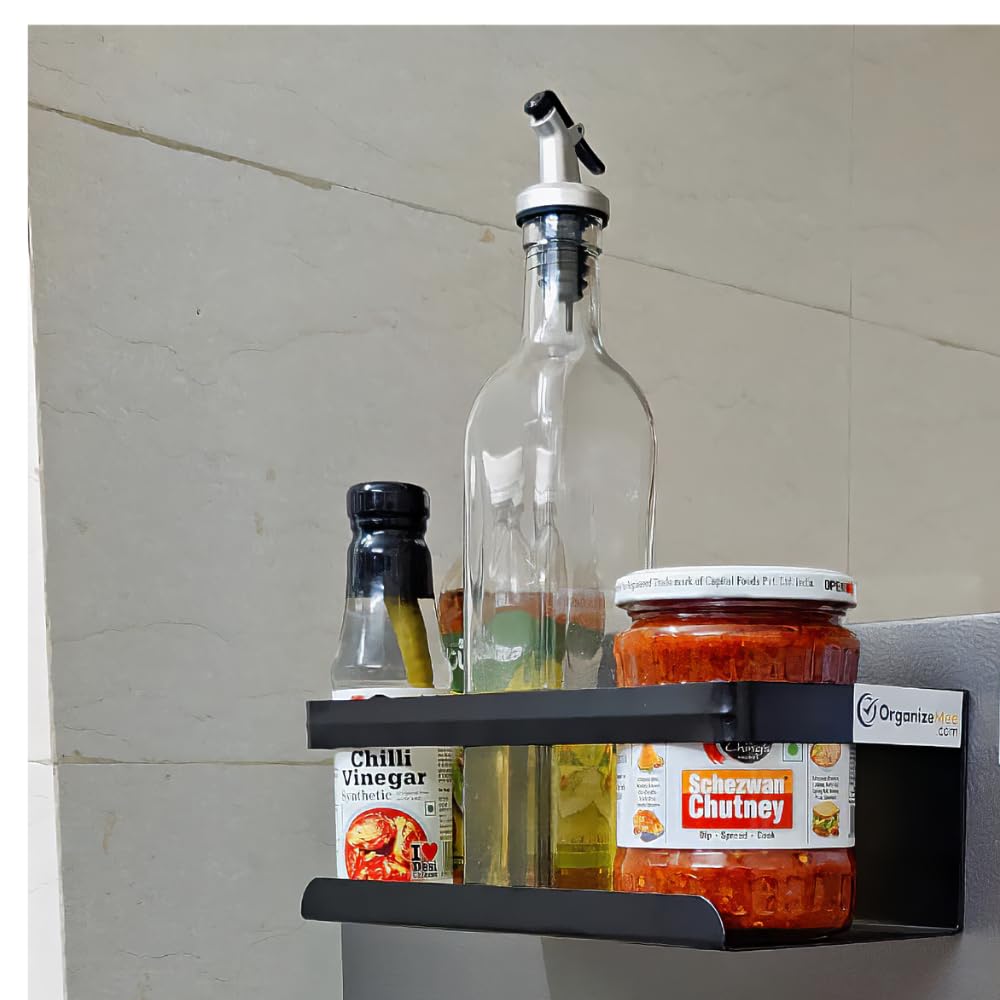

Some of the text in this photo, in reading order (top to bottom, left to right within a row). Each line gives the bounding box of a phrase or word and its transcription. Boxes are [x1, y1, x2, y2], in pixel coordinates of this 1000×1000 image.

[351, 750, 412, 768] Chilli
[342, 769, 427, 790] Vinegar
[688, 772, 785, 794] Schezwan
[341, 789, 393, 801] Synthetic
[688, 794, 785, 824] Chutney
[699, 831, 776, 840] Dip Spread Cook
[411, 844, 421, 861] I
